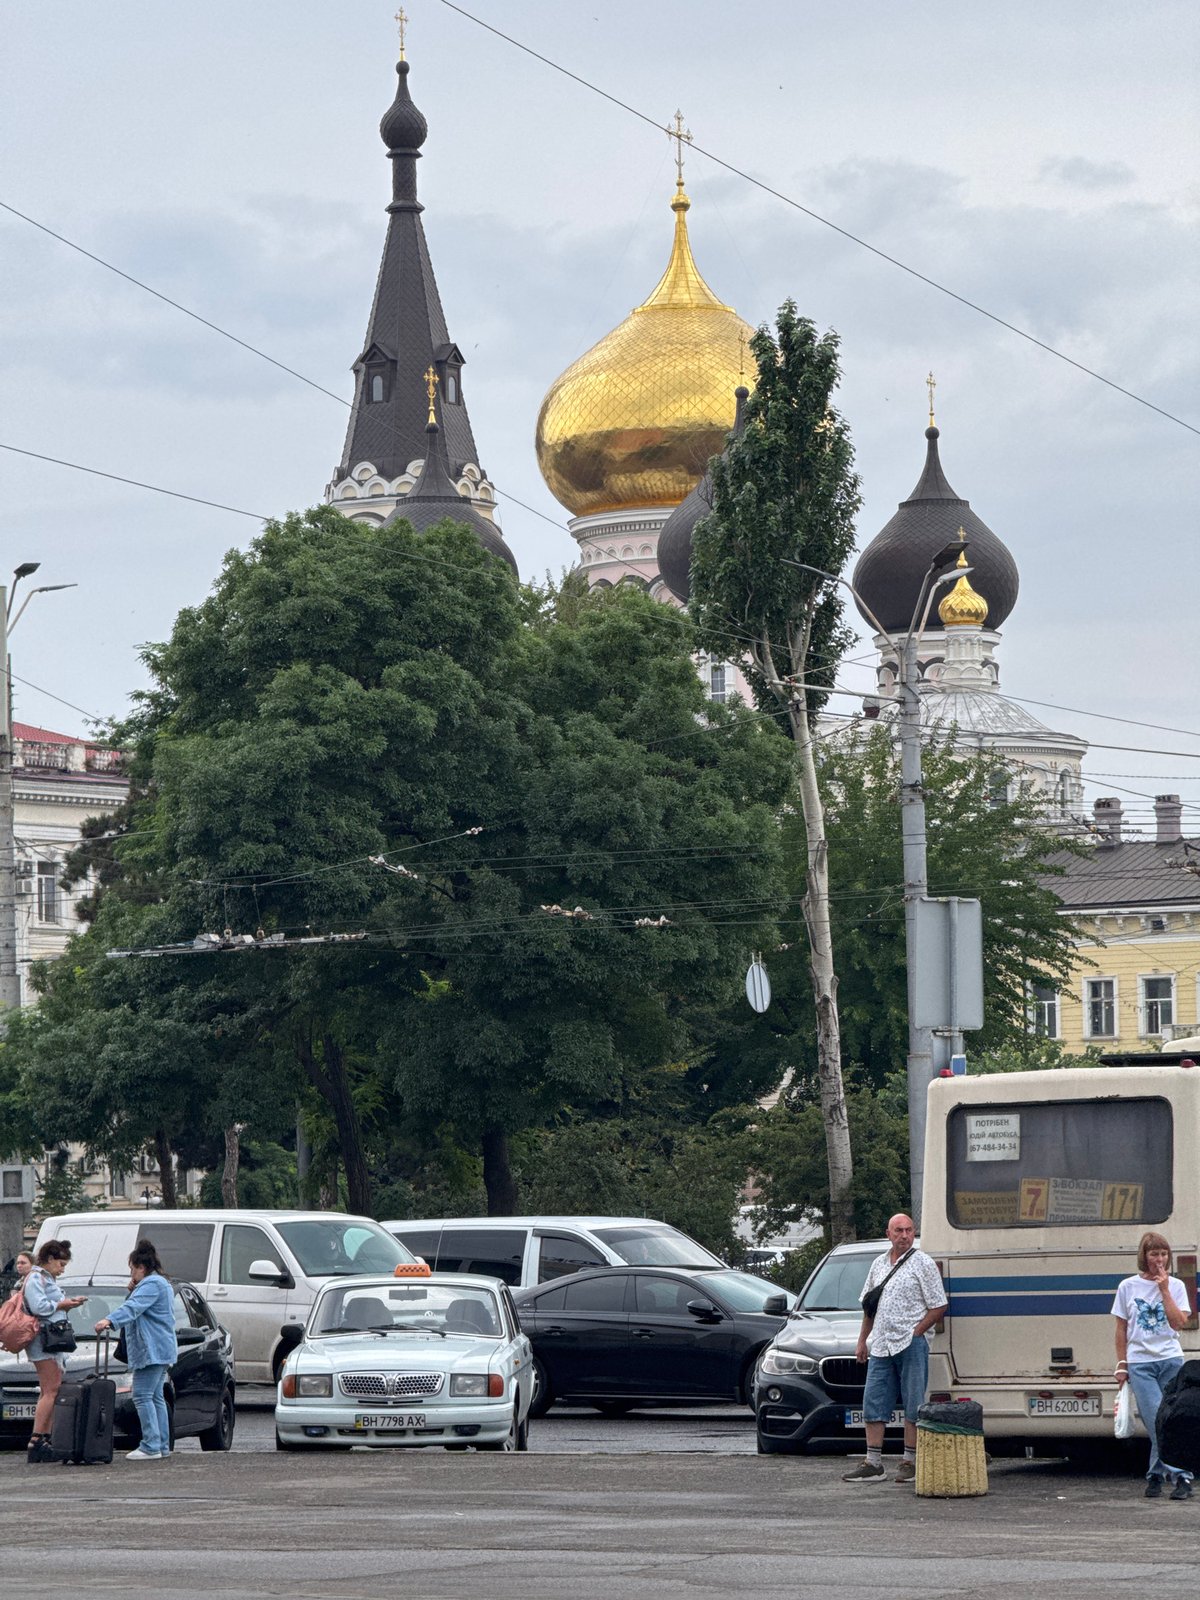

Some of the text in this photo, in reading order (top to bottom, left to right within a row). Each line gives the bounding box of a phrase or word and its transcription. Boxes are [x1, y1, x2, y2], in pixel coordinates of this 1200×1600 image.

[975, 1119, 1009, 1127] ПОТРІБЕН
[988, 1131, 1017, 1139] АВТОБУСА
[1026, 1188, 1041, 1216] 7
[1107, 1187, 1139, 1219] 171
[9, 1405, 36, 1417] BH 18
[1037, 1401, 1053, 1413] BH
[1055, 1401, 1079, 1412] 6200
[362, 1416, 422, 1427] BH 7798 AX
